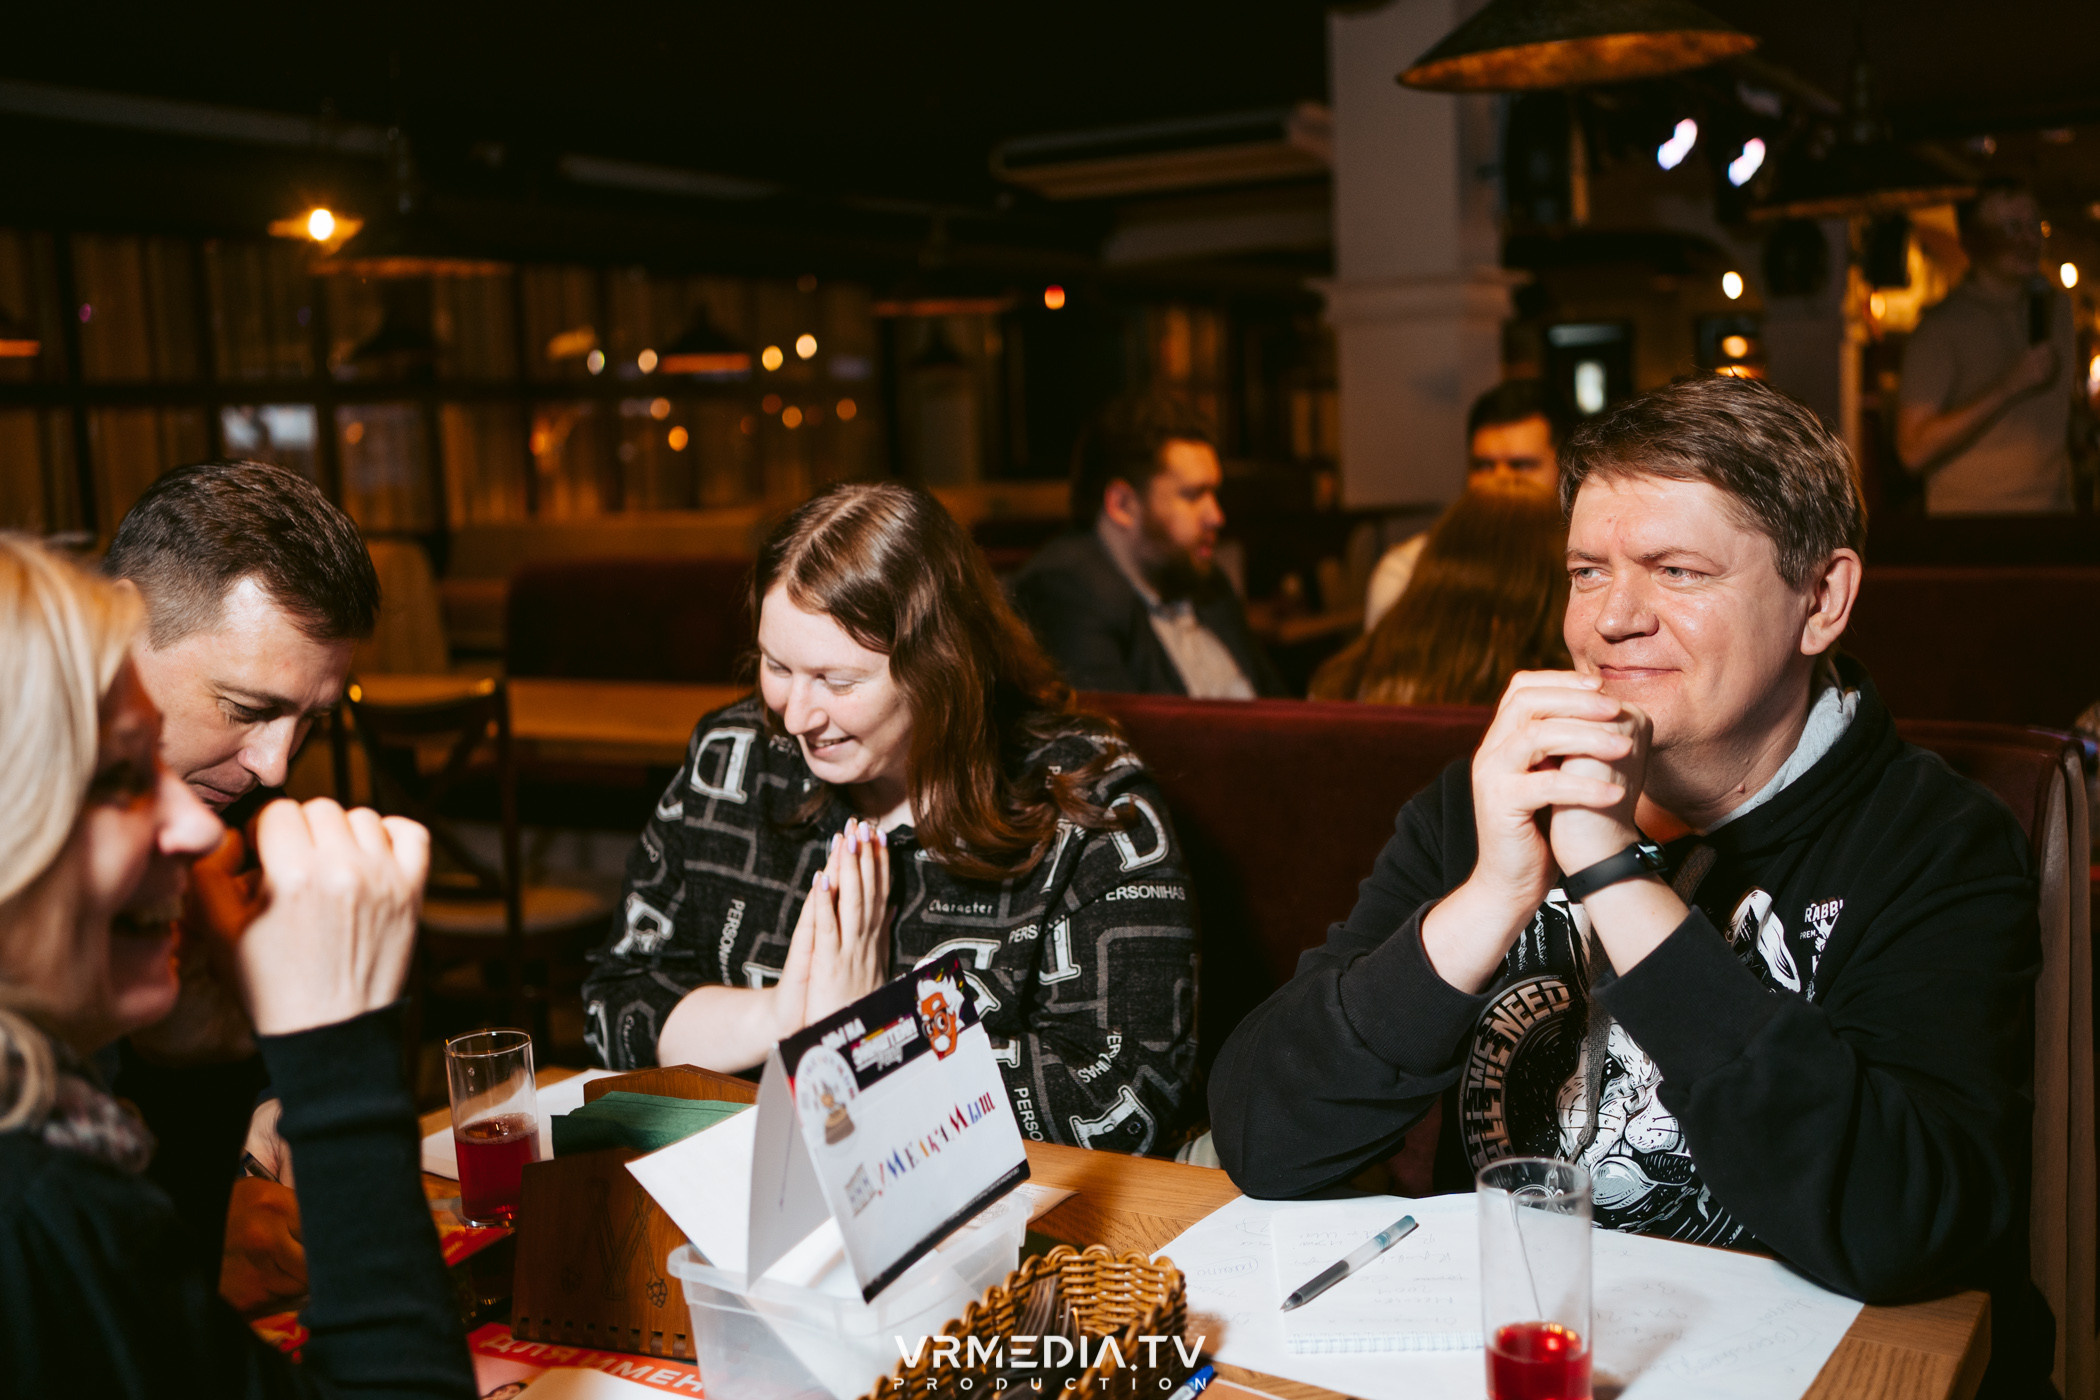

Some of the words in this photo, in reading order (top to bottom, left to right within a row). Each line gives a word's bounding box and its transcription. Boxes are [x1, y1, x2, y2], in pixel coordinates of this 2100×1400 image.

[1105, 885, 1185, 901] ERSONIHAS
[1008, 924, 1042, 944] PERS
[1483, 980, 1572, 1044] NEED
[1014, 1087, 1045, 1142] PERSO
